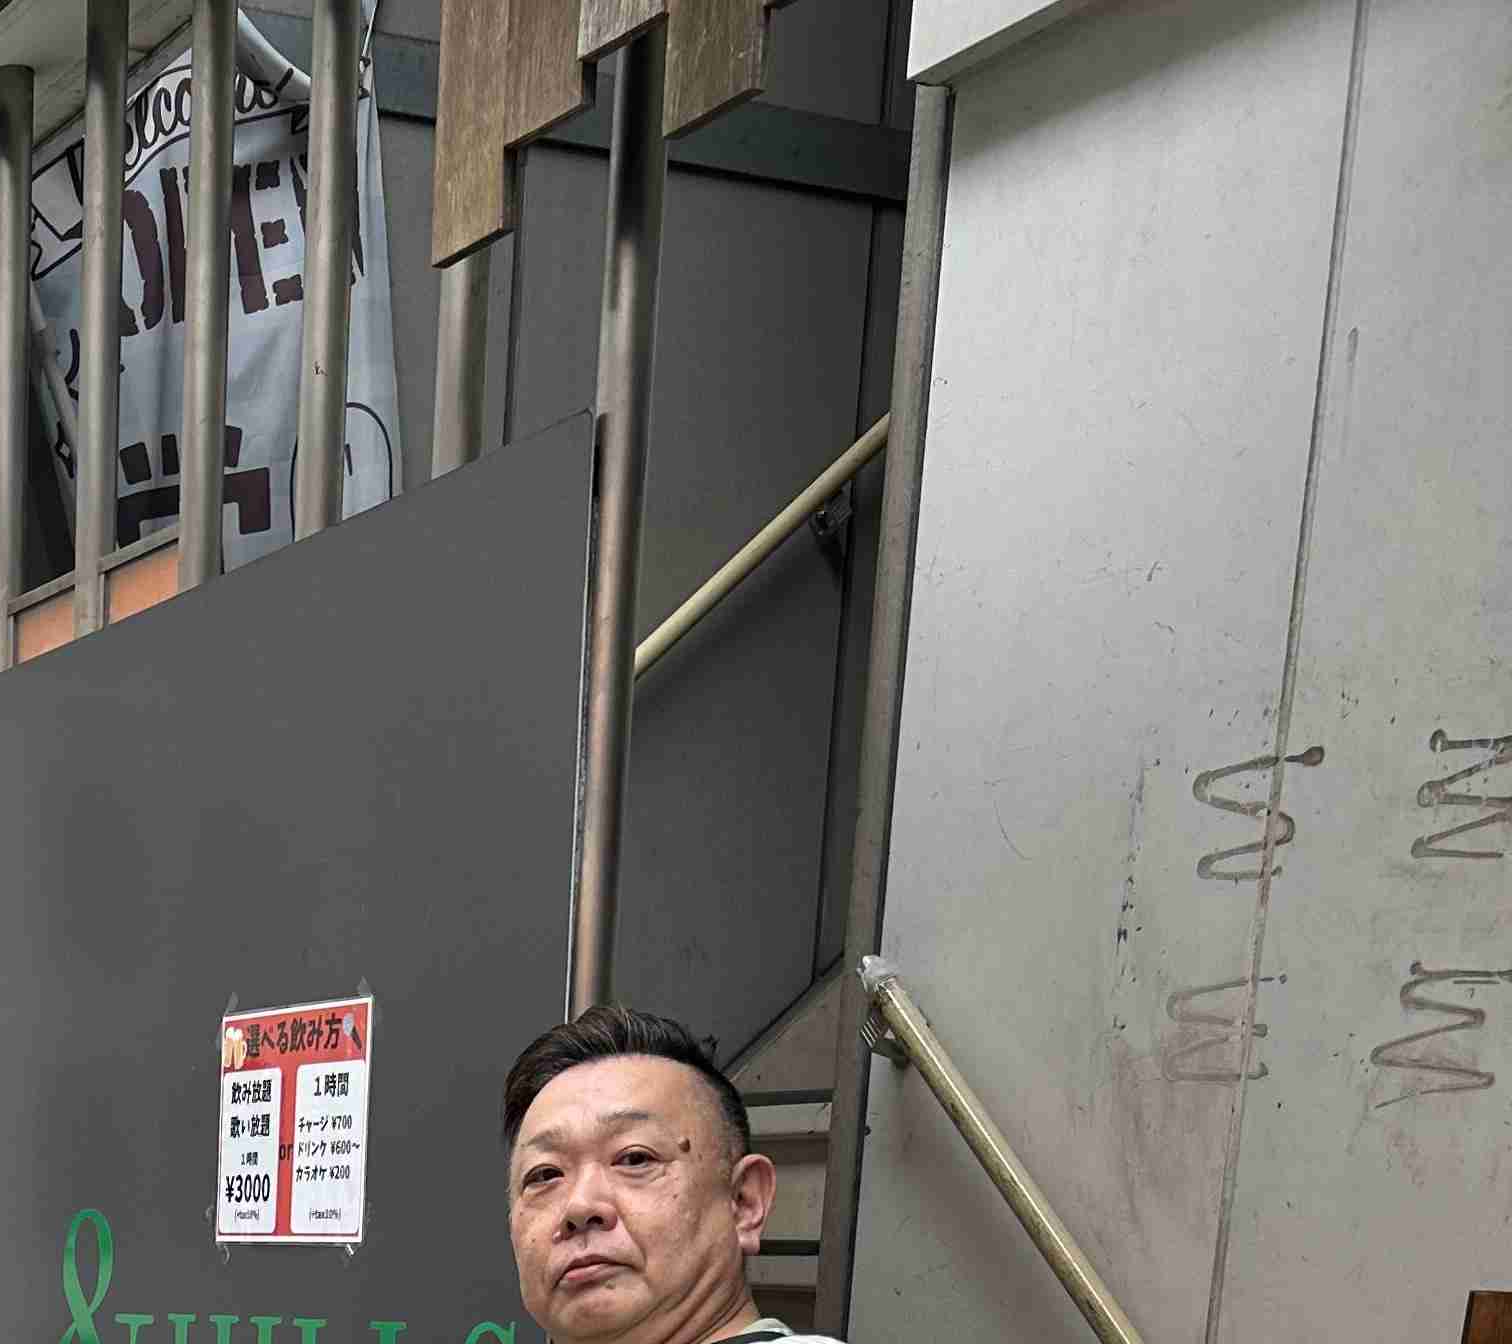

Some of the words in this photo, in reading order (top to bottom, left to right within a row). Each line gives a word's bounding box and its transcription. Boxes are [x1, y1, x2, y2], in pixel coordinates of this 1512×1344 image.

[246, 1013, 342, 1057] 選べる飲み方
[231, 1079, 272, 1105] 飲み放題
[298, 1114, 329, 1133] チャージ
[297, 1140, 327, 1158] ドリンク
[296, 1164, 327, 1183] カラオケ
[226, 1174, 271, 1203] ¥3000
